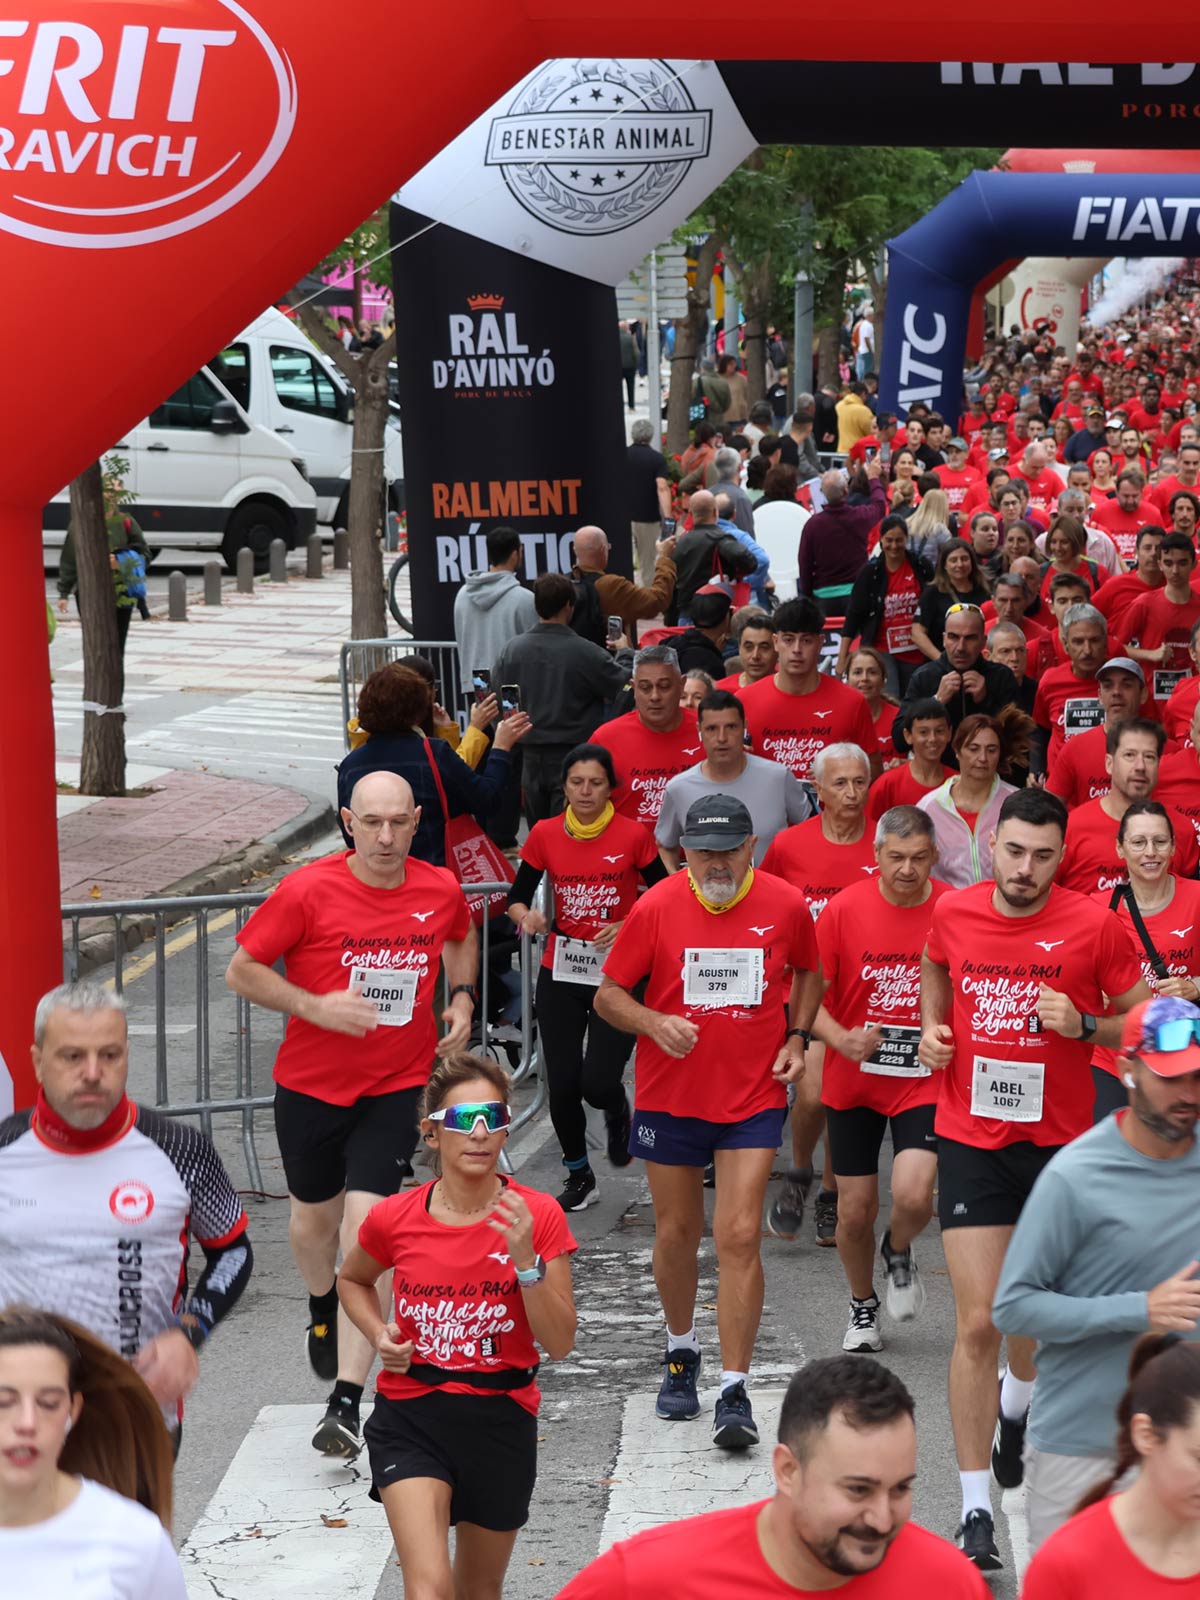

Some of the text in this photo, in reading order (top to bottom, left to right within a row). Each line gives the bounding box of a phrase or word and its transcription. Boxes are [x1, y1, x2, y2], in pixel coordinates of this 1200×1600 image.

[502, 127, 695, 150] BENESTAR ANIMAL
[449, 312, 529, 355] RAL
[433, 349, 555, 389] D'AVINYÓ
[432, 479, 582, 518] RALMENT
[341, 949, 428, 967] Castell d'Aro
[565, 953, 597, 965] MARTA
[698, 968, 739, 978] AGUSTIN
[861, 964, 907, 981] Castell
[977, 962, 1011, 976] cursa
[362, 987, 403, 1001] JORDI
[708, 982, 728, 991] 379
[961, 977, 1010, 998] Castell
[868, 993, 918, 1012] S'Agaró
[975, 995, 1018, 1018] Platja
[971, 1012, 1026, 1037] S'Agaró
[879, 1054, 905, 1065] 2229
[990, 1080, 1025, 1096] ABEL
[993, 1096, 1021, 1108] 1067
[412, 1283, 455, 1297] cursa
[459, 1282, 477, 1297] de
[399, 1298, 507, 1322] Castell d'Aro
[416, 1318, 515, 1342] Platja d'Aro
